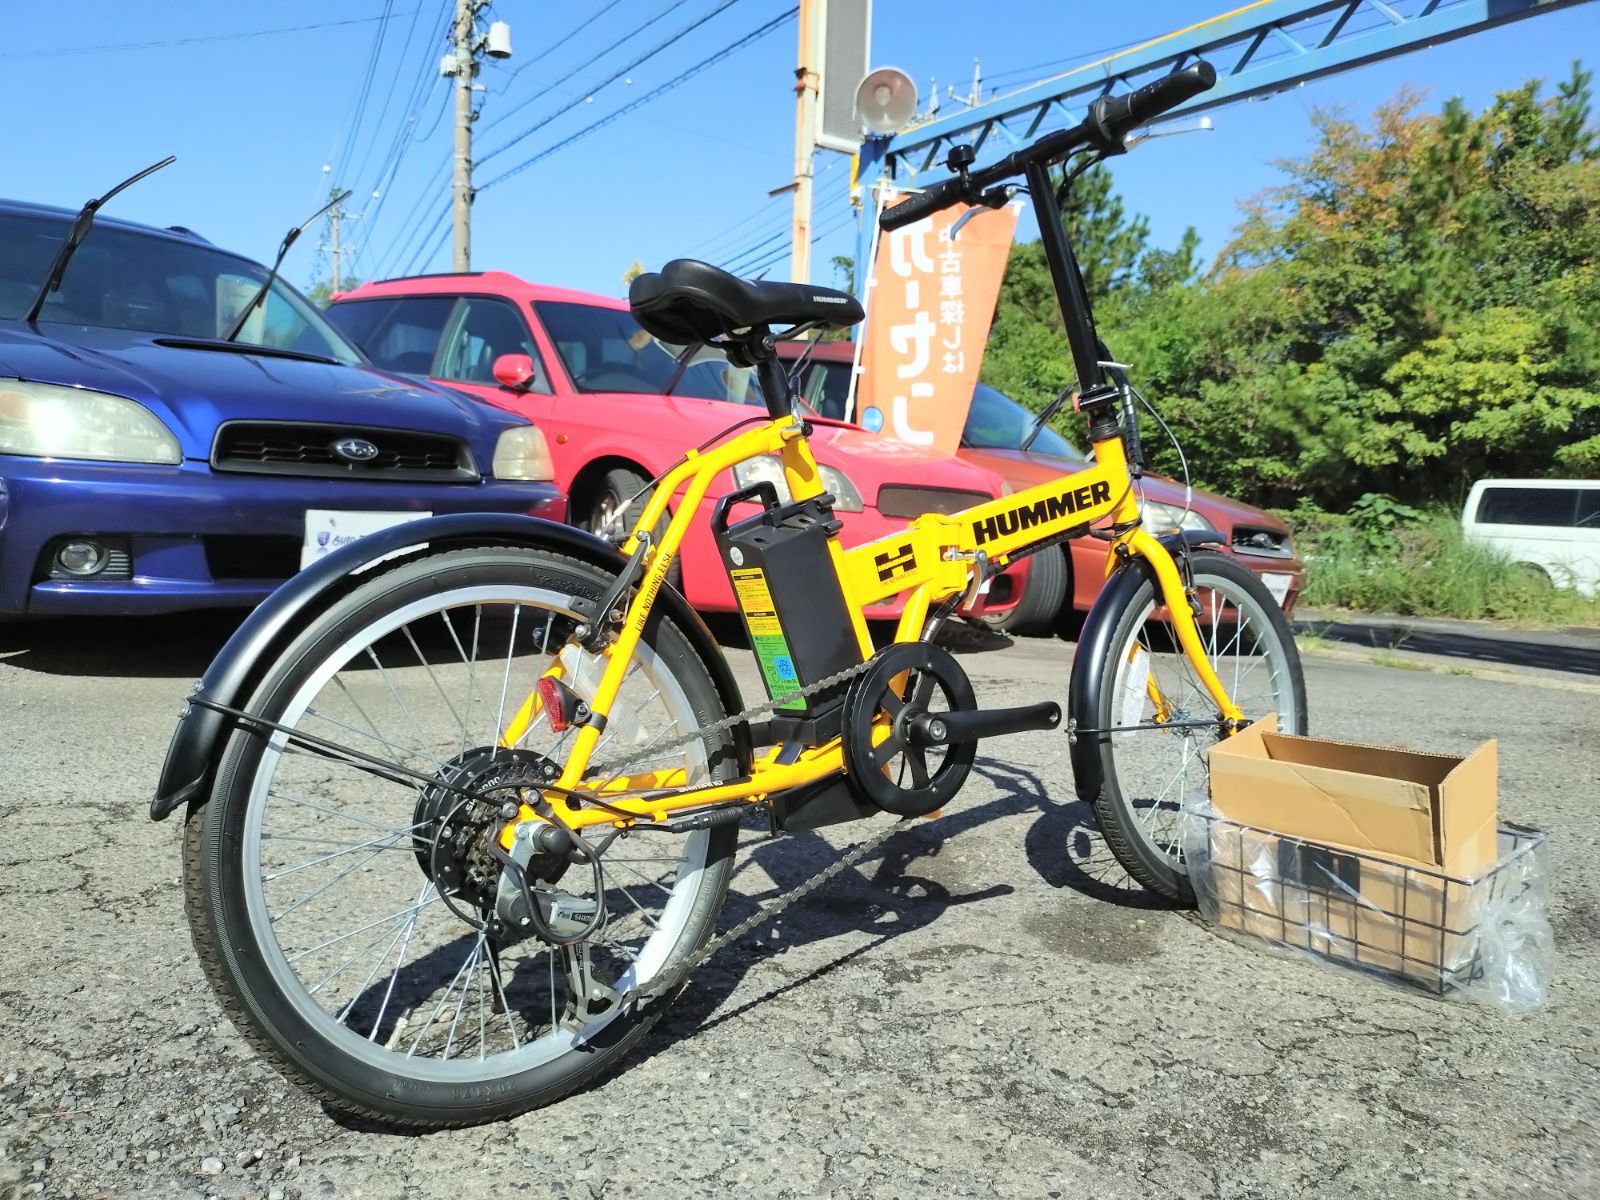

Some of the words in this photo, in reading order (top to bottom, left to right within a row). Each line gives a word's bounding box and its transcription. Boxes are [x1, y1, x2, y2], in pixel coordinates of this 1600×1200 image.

[812, 295, 849, 305] HUMMER
[972, 480, 1112, 546] HUMMER
[634, 612, 647, 633] LIKE
[643, 573, 663, 612] NOTHING
